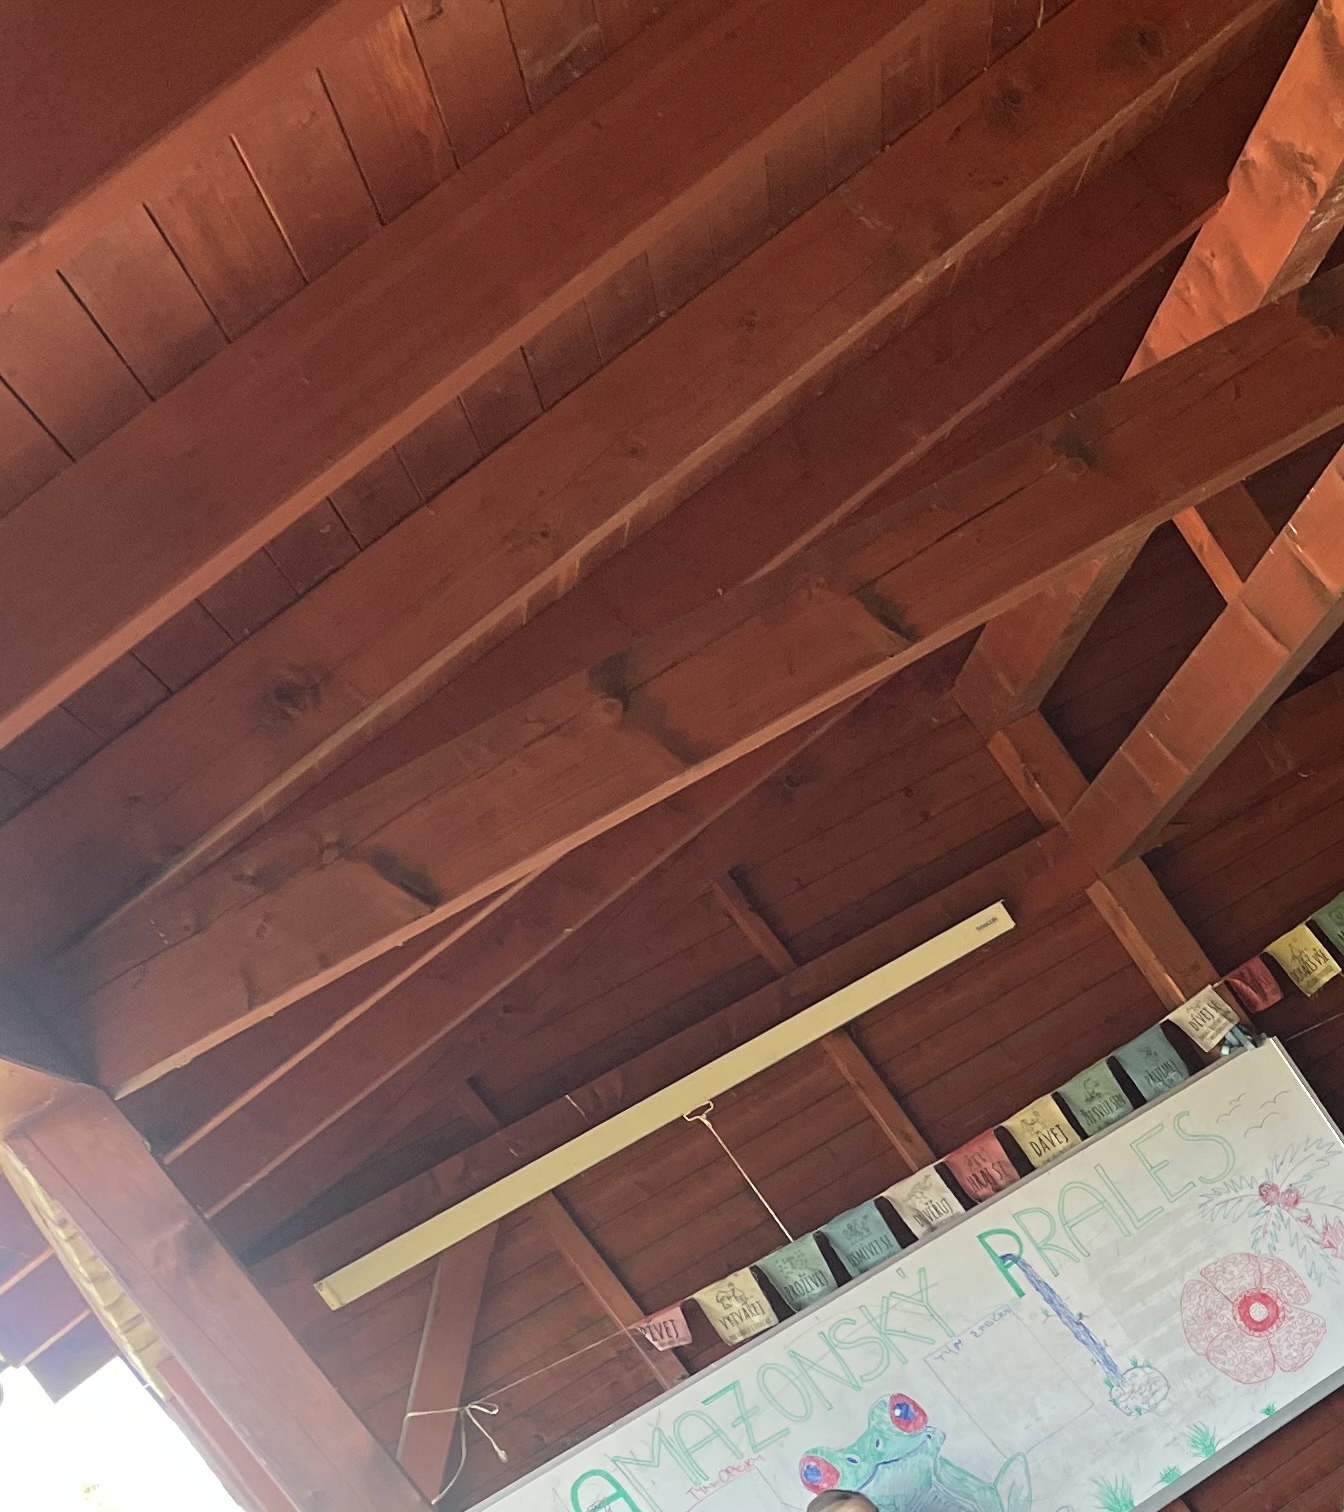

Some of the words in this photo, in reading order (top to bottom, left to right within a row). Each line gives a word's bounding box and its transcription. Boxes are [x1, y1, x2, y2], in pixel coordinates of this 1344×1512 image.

[1188, 1003, 1216, 1032] DÍVEJ
[1028, 1123, 1070, 1158] DÁVEJ
[976, 1110, 1234, 1299] PRALES
[782, 1269, 830, 1300] PROŽÍVEJ
[718, 1299, 767, 1331] VYTVÁŘEJ
